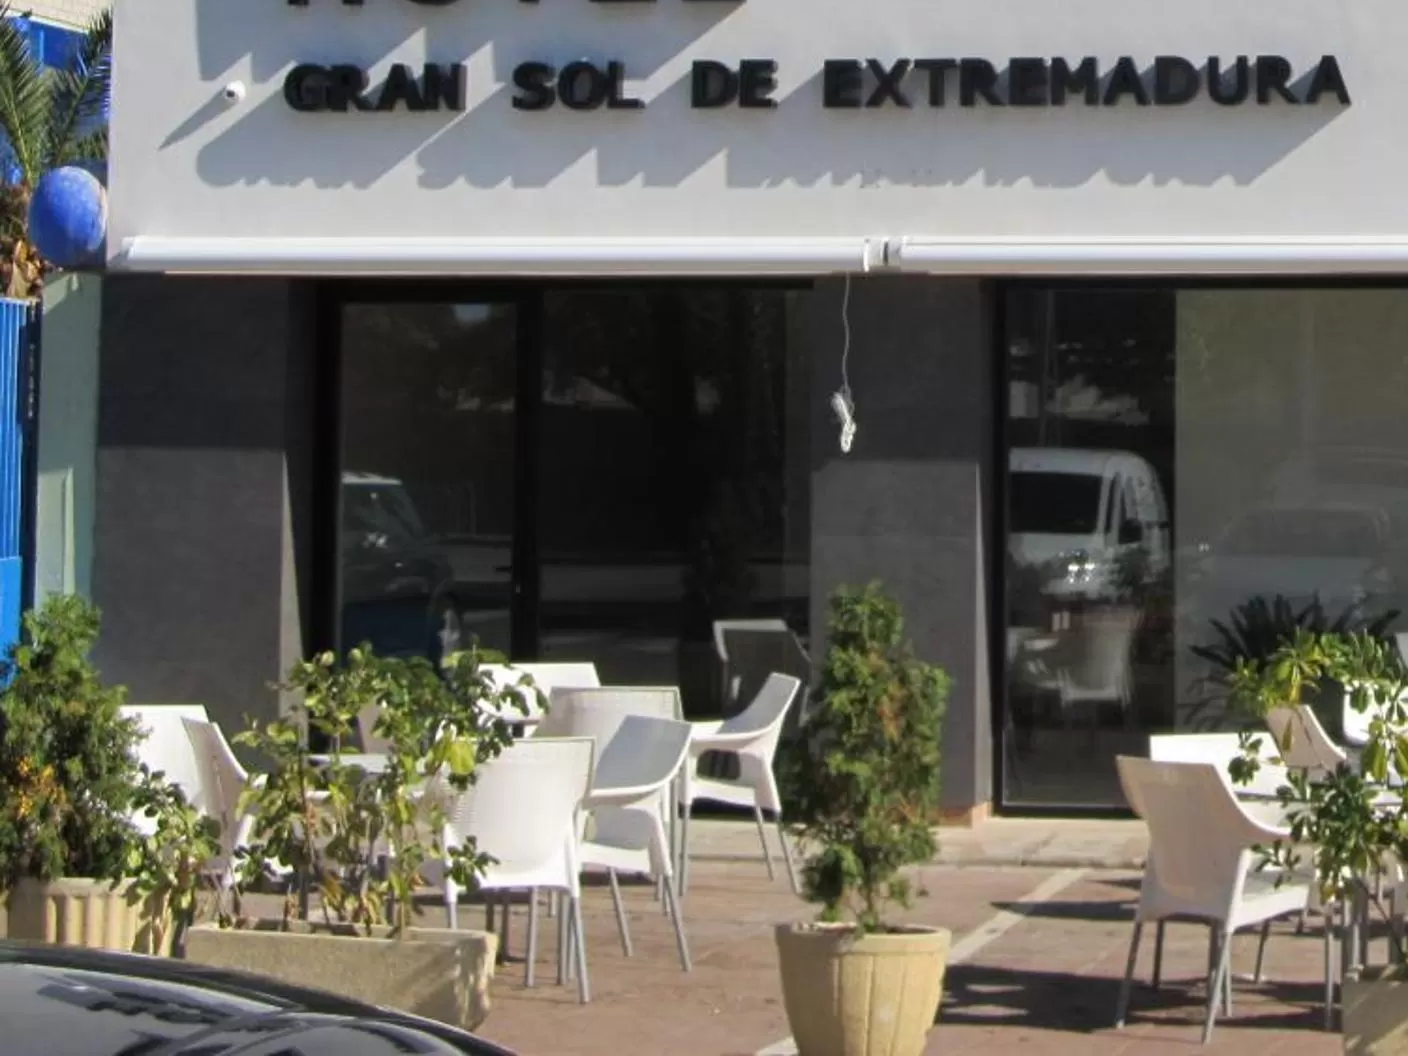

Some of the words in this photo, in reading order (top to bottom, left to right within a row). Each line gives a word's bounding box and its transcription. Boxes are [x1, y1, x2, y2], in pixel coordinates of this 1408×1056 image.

[284, 61, 466, 113] GRAN
[511, 59, 645, 111] SOL
[690, 58, 778, 109] DE
[823, 55, 1351, 109] EXTREMADURA
